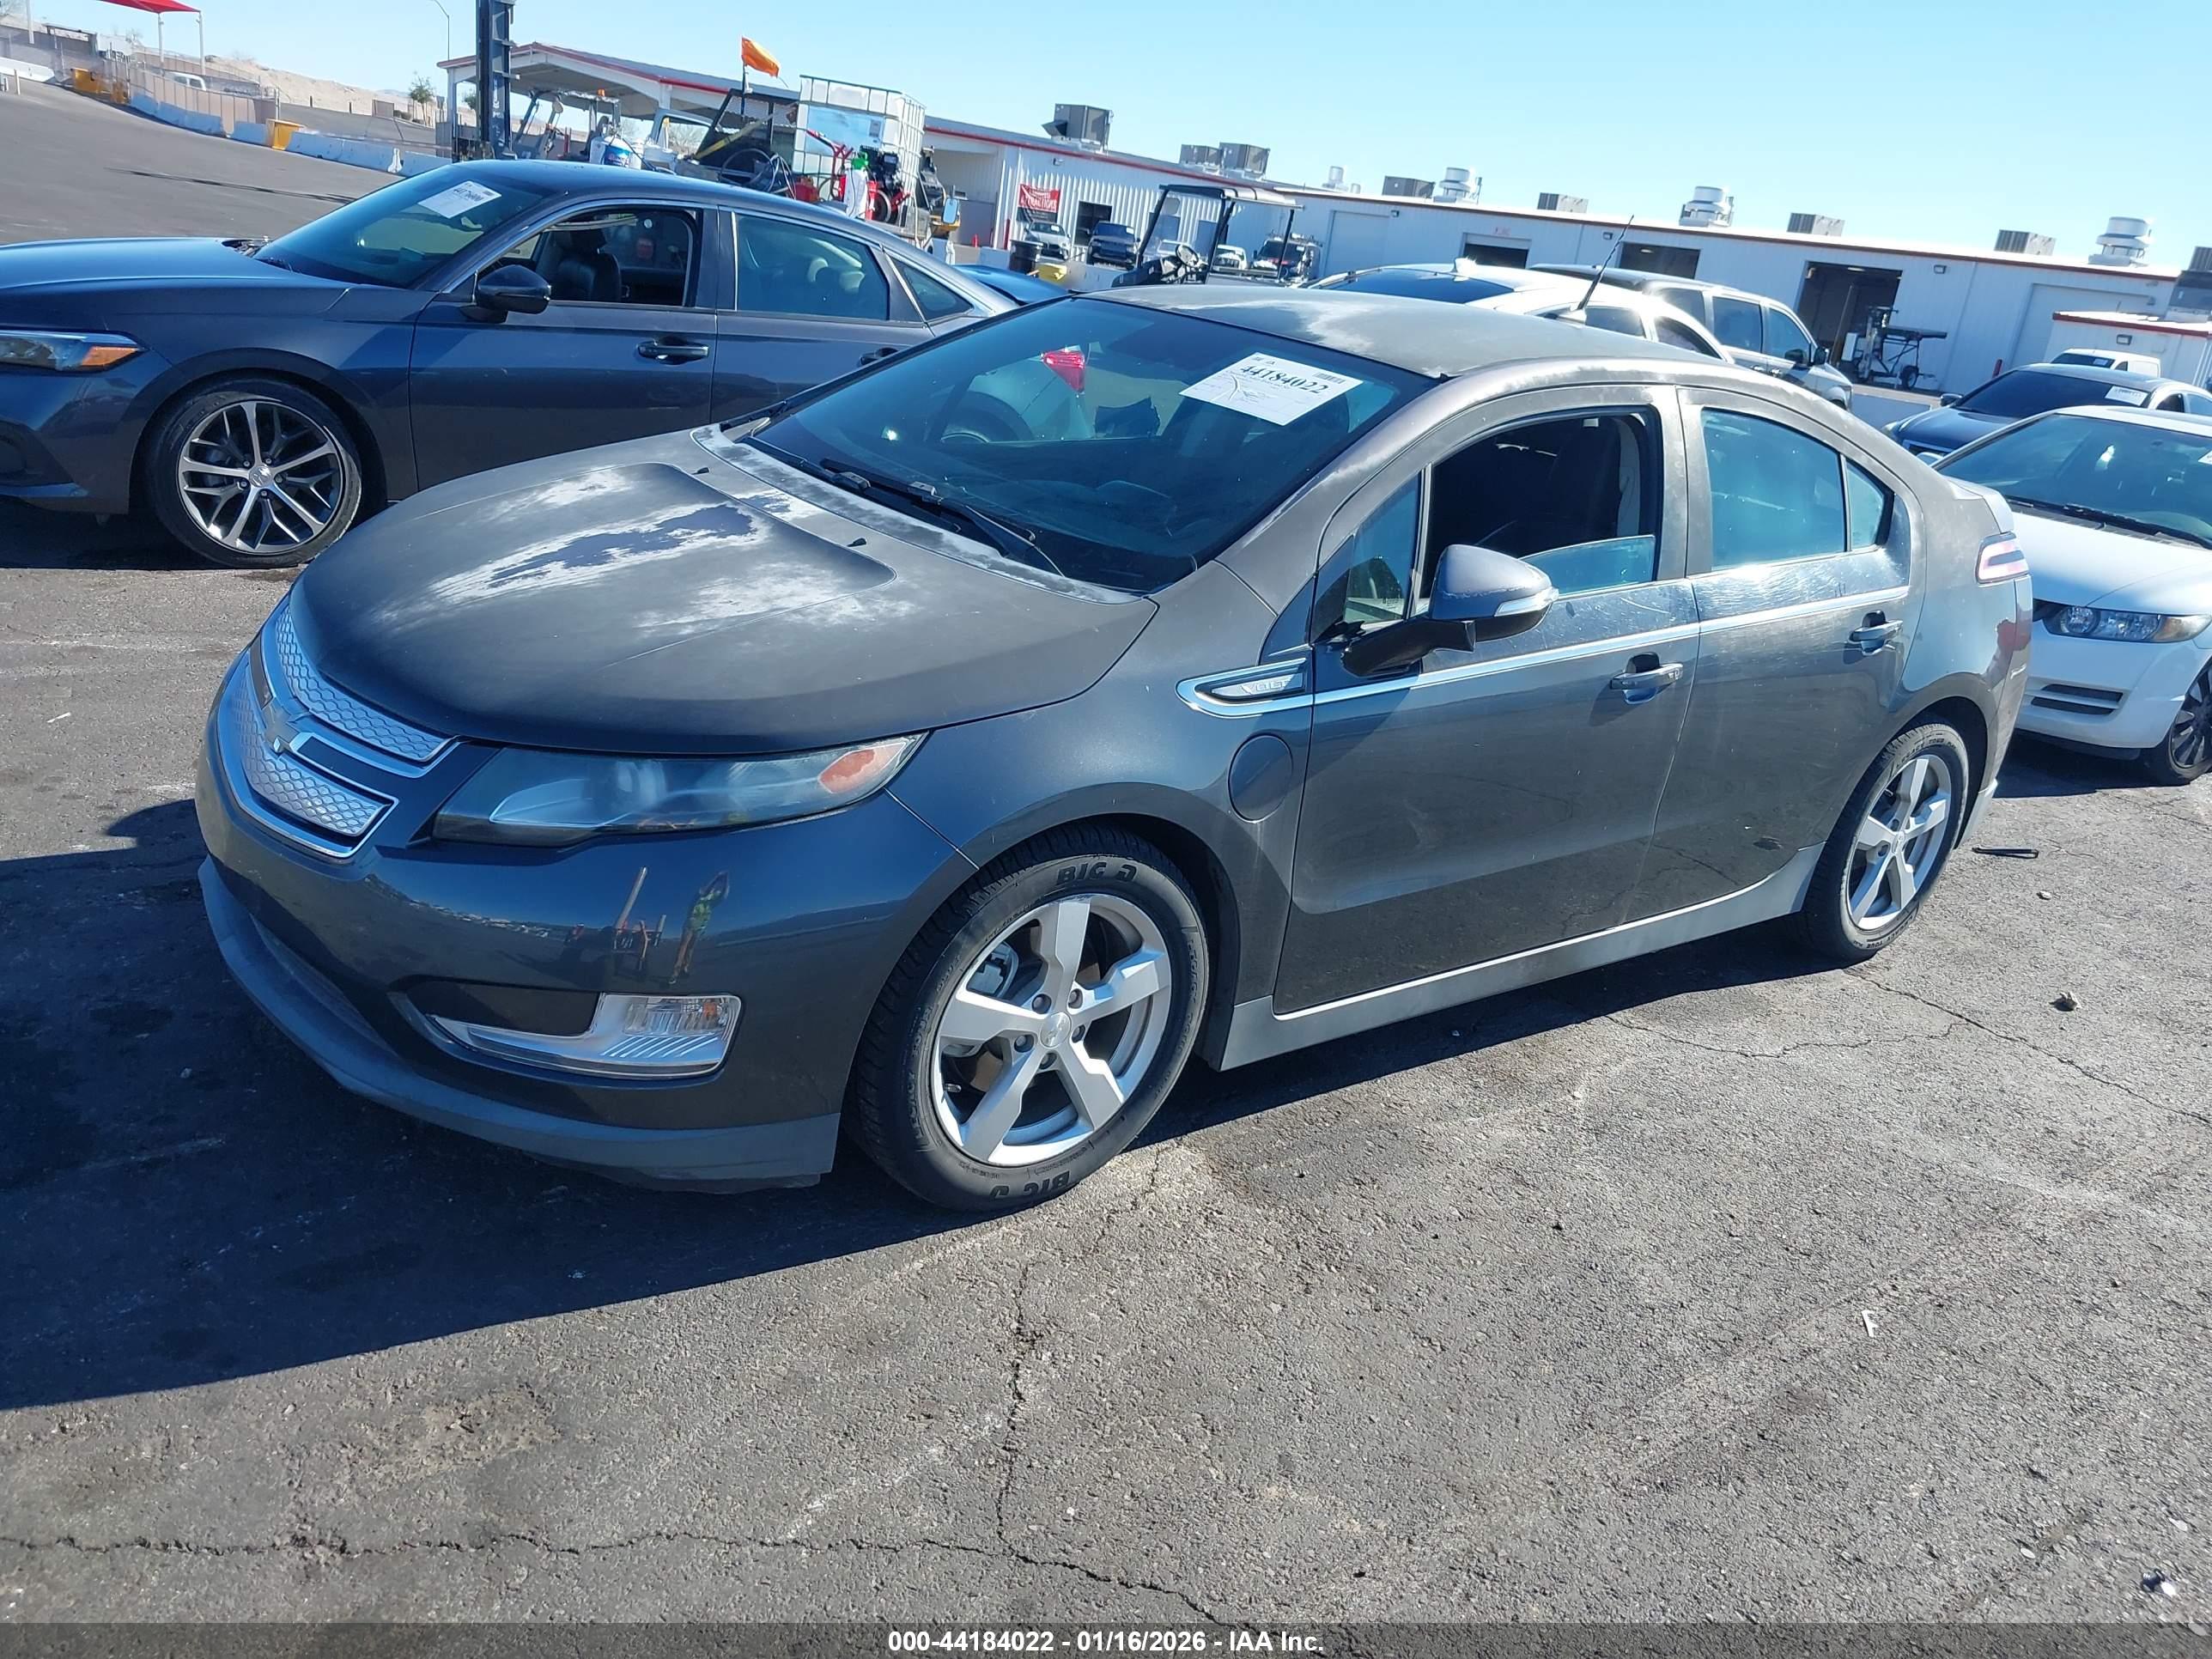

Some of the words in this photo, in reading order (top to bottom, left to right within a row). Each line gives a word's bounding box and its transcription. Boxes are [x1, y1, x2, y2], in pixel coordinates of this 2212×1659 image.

[1240, 365, 1329, 394] 44184022
[1241, 678, 1291, 695] VOLT
[1056, 861, 1107, 885] BIG
